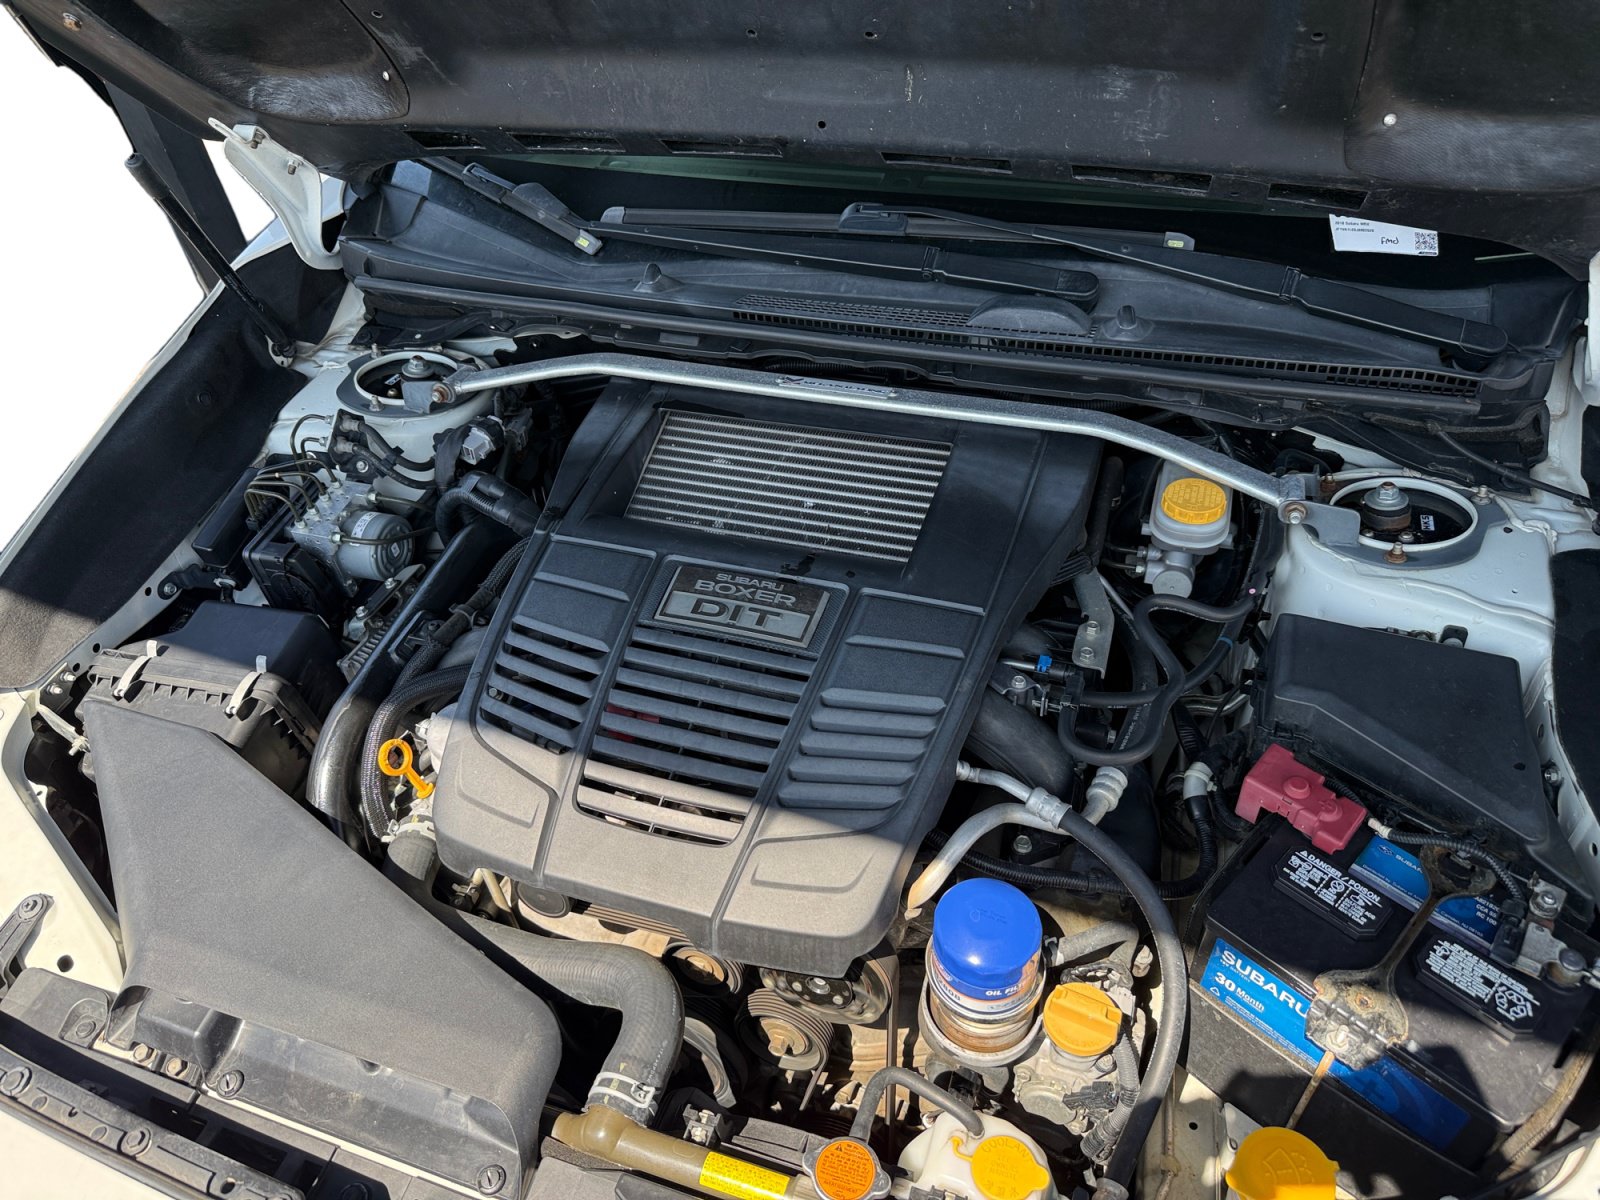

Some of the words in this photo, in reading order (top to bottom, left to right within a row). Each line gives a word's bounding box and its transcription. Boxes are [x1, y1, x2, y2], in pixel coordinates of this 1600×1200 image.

[694, 579, 796, 607] BOXER
[715, 573, 784, 592] SUBARU
[690, 598, 784, 628] DIT
[1308, 854, 1342, 878] DANGER
[1348, 880, 1381, 902] POISON
[1215, 972, 1236, 992] 30
[1236, 987, 1265, 1012] Month
[1221, 950, 1309, 1018] SUBARU
